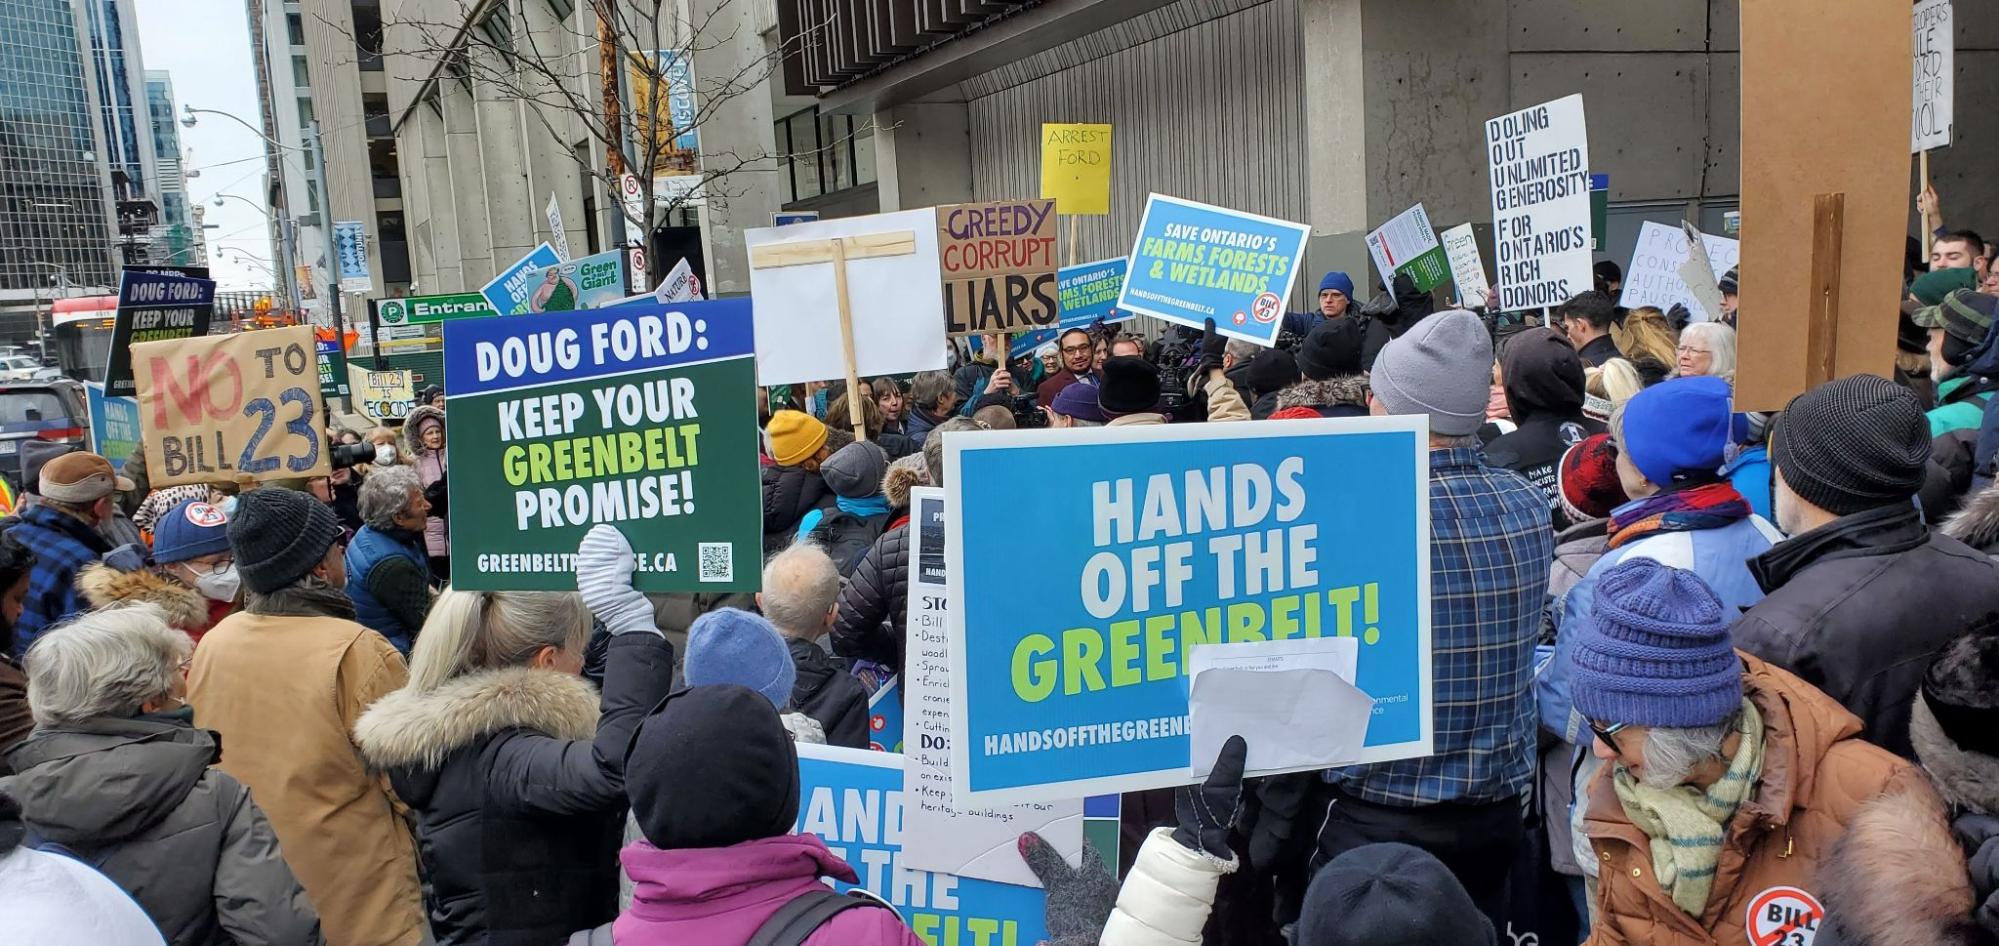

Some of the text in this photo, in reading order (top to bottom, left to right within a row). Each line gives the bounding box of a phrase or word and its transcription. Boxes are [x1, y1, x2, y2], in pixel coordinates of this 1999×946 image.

[1914, 27, 1935, 58] ULE
[1916, 50, 1942, 81] ORD
[1490, 106, 1549, 142] DOLING
[1914, 101, 1941, 141] OOL
[1048, 130, 1110, 145] ARREST
[1493, 137, 1525, 165] OUT
[1059, 149, 1101, 166] FORD
[1494, 148, 1580, 188] UNLIMITED
[1497, 170, 1588, 211] GENEROSITY
[948, 202, 1054, 240] GREEDY
[1499, 214, 1532, 240] FOR
[1164, 223, 1277, 252] SAVE ONTARIO'S
[1500, 226, 1584, 263] ONTARIO'S
[581, 261, 616, 276] Green
[944, 238, 1055, 272] CORRUPT
[1208, 246, 1289, 276] FORESTS
[1637, 255, 1676, 272] CONS
[504, 261, 538, 292] HANDS
[582, 271, 617, 290] Giant
[1072, 268, 1115, 285] ONTARIO'S
[1150, 260, 1270, 295] & WETLANDS
[1501, 258, 1540, 286] RICH
[130, 282, 203, 301] DOUG FORD:
[945, 273, 1057, 332] LIARS
[132, 309, 194, 329] KEEP YOUR
[414, 302, 488, 316] Entran
[476, 311, 708, 381] DOUG FORD:
[149, 343, 307, 430] NO TO
[498, 377, 698, 441] KEEP YOUR
[162, 387, 319, 476] BILL 23
[504, 424, 700, 486] GREENBELT
[1528, 465, 1552, 479] MAKE
[515, 470, 695, 530] PROMISE!
[1092, 456, 1306, 547] HANDS
[477, 553, 677, 572] GREENBELTPE.CA
[1080, 523, 1319, 619] OFF THE
[921, 614, 942, 628] Bill
[922, 648, 948, 658] woodl
[1011, 583, 1380, 702] GREENBELT!
[922, 708, 949, 719] expen
[923, 721, 949, 733] Cuttin
[921, 734, 950, 750] DO:
[921, 754, 949, 767] Build
[922, 787, 946, 800] Keep
[1768, 903, 1815, 931] BILL
